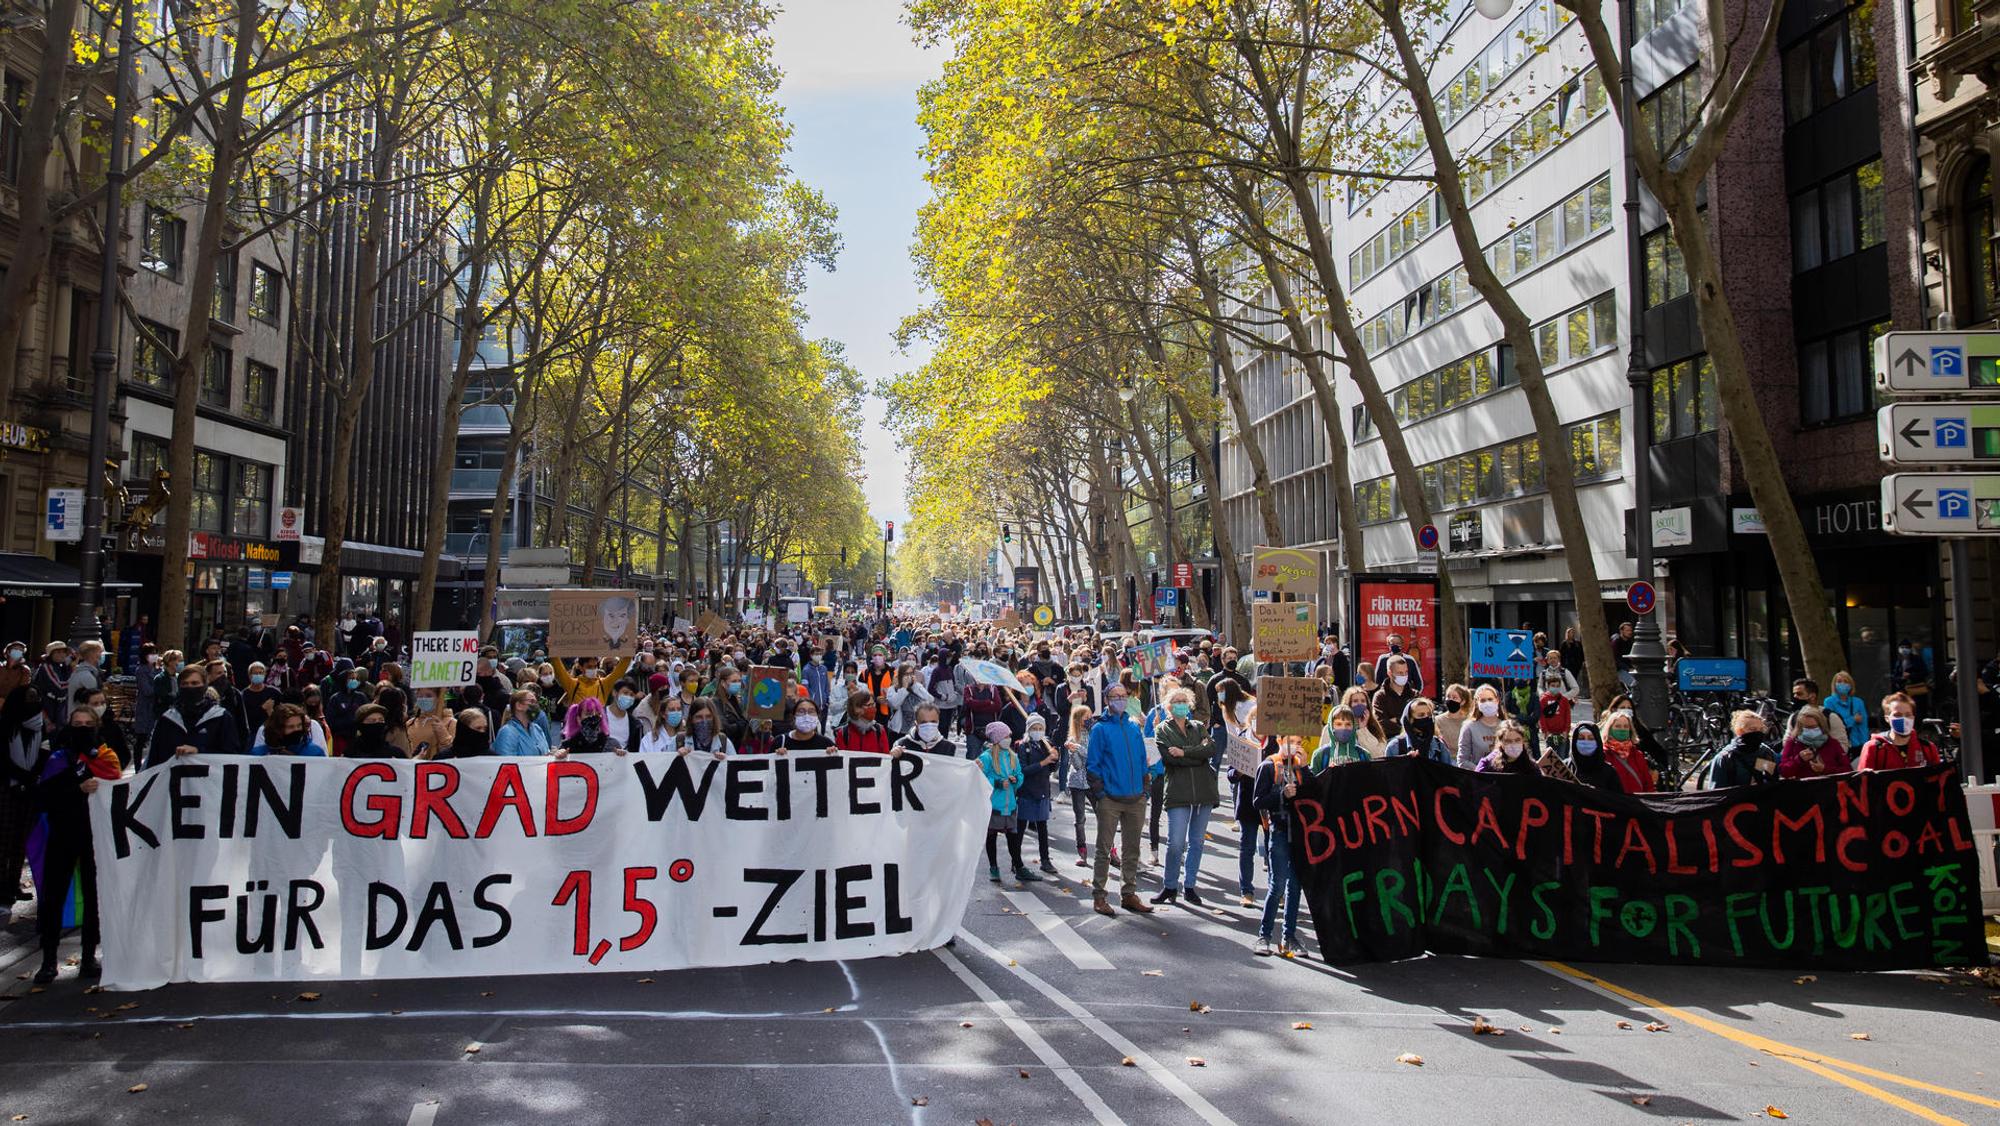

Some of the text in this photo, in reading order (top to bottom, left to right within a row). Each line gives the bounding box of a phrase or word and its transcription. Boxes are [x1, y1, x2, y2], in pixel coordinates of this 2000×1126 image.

[1817, 501, 1878, 535] HOTE
[209, 536, 240, 560] Kiosk
[246, 542, 280, 561] Naftoon
[1257, 564, 1279, 578] go
[1166, 590, 1175, 604] P
[1371, 595, 1423, 612] FÜR HERZ
[1367, 614, 1429, 627] UND KEHLE.
[414, 637, 479, 654] THERE IS NO
[1474, 631, 1500, 645] TIME
[1484, 645, 1494, 658] IS
[412, 660, 474, 682] PLANET B
[110, 751, 925, 860] KEIN GRAD WEITER
[1836, 767, 1957, 825] NOT
[1295, 786, 1826, 874] BURN CAPITALISM
[1835, 817, 1973, 872] COAL
[365, 873, 513, 951] DAS
[551, 858, 695, 966] 1,5°
[1586, 886, 1701, 958] FOR
[1726, 881, 1924, 957] FUTURE
